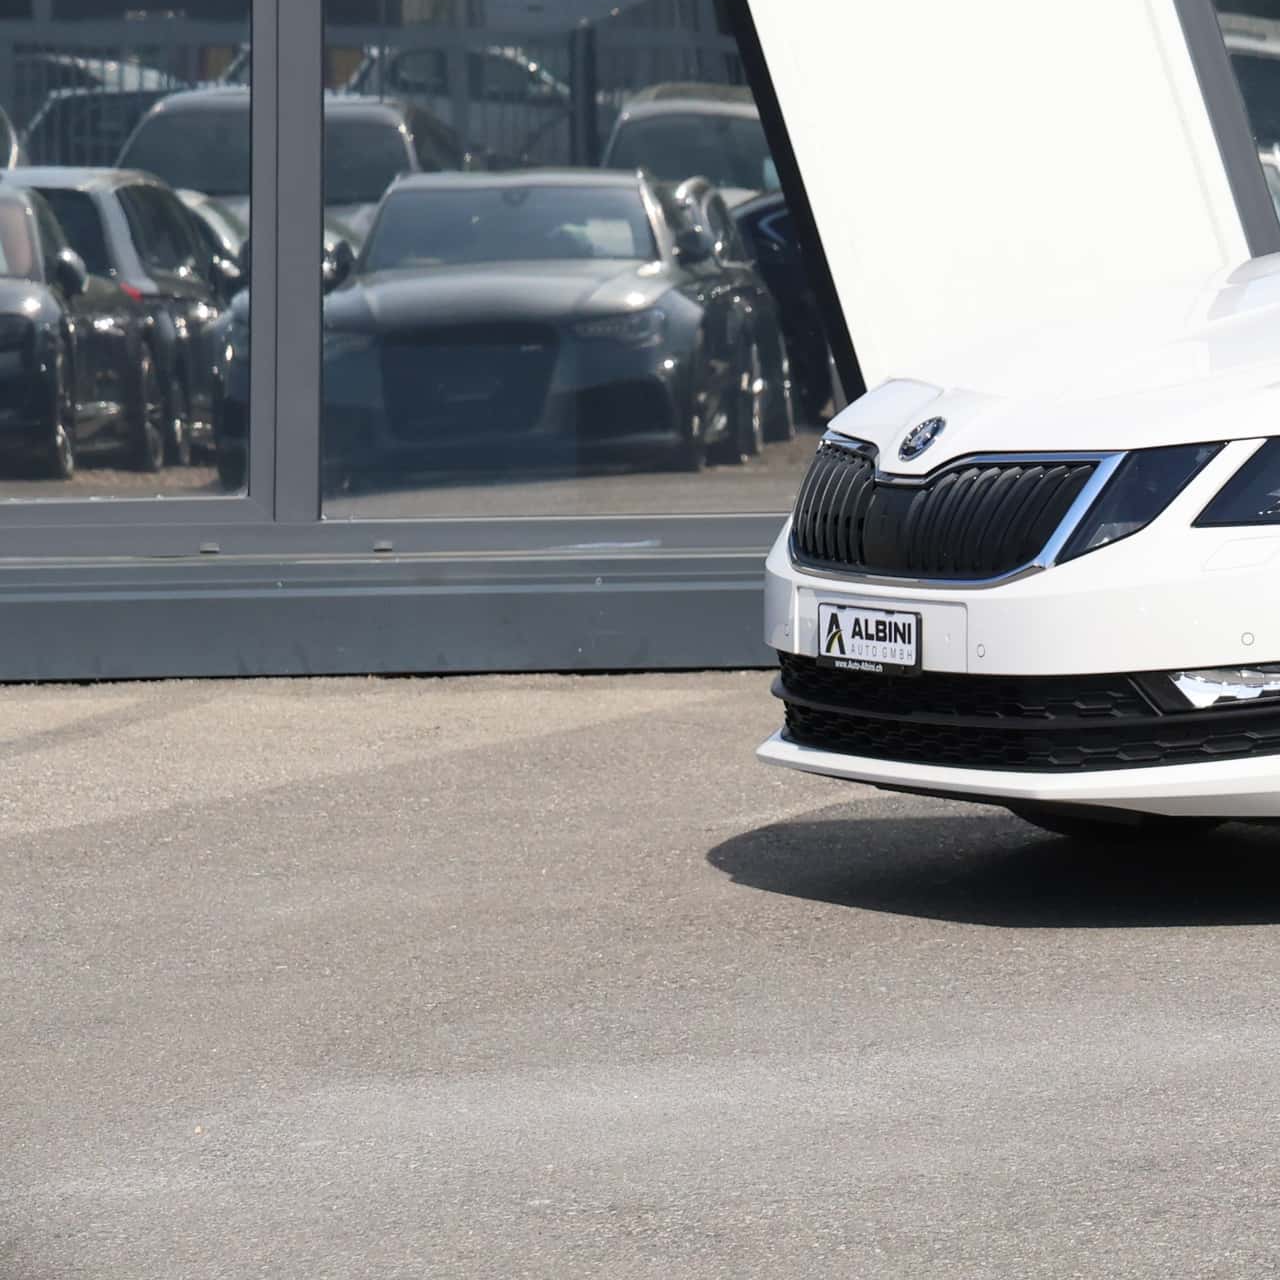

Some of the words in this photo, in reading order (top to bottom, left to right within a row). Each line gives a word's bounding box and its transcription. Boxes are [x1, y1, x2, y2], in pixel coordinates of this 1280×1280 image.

[851, 617, 912, 645] ALBINI
[851, 644, 877, 657] AUTO
[882, 646, 912, 661] GMBH
